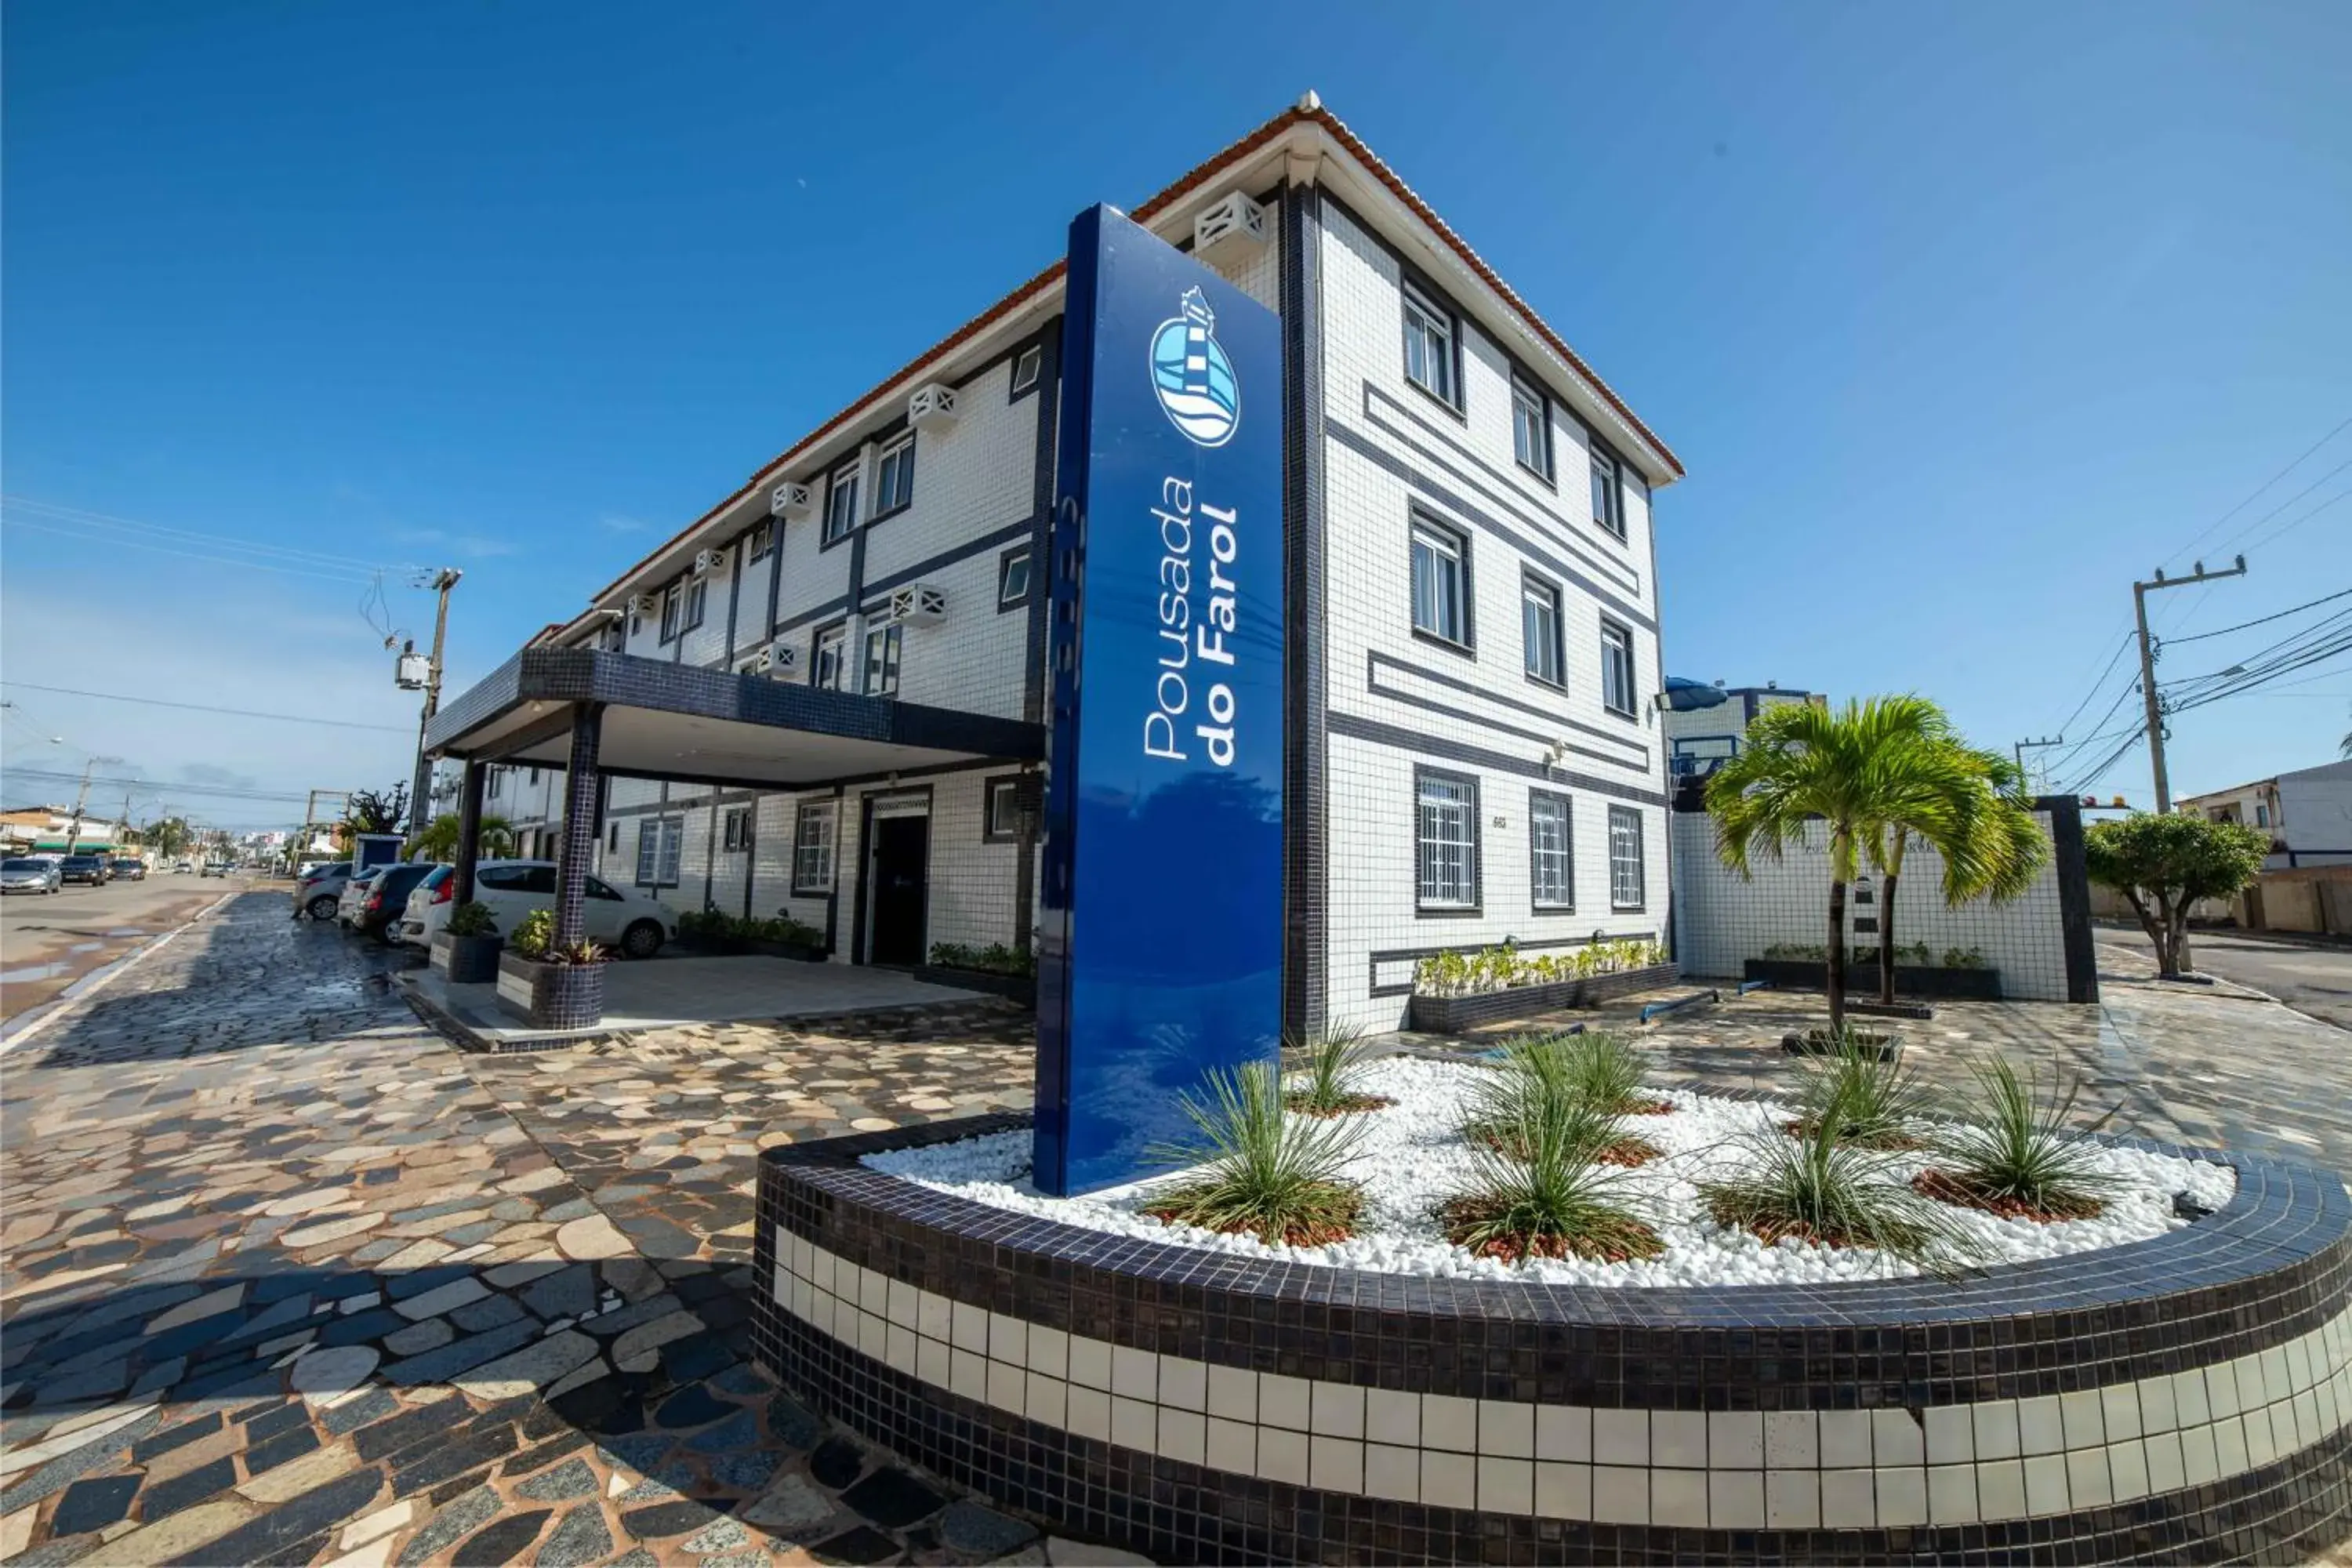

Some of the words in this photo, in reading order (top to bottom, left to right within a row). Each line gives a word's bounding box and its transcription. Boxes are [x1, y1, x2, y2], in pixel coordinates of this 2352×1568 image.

[1144, 476, 1193, 760] Pousada
[1197, 503, 1236, 666] Farol
[1196, 684, 1236, 767] do
